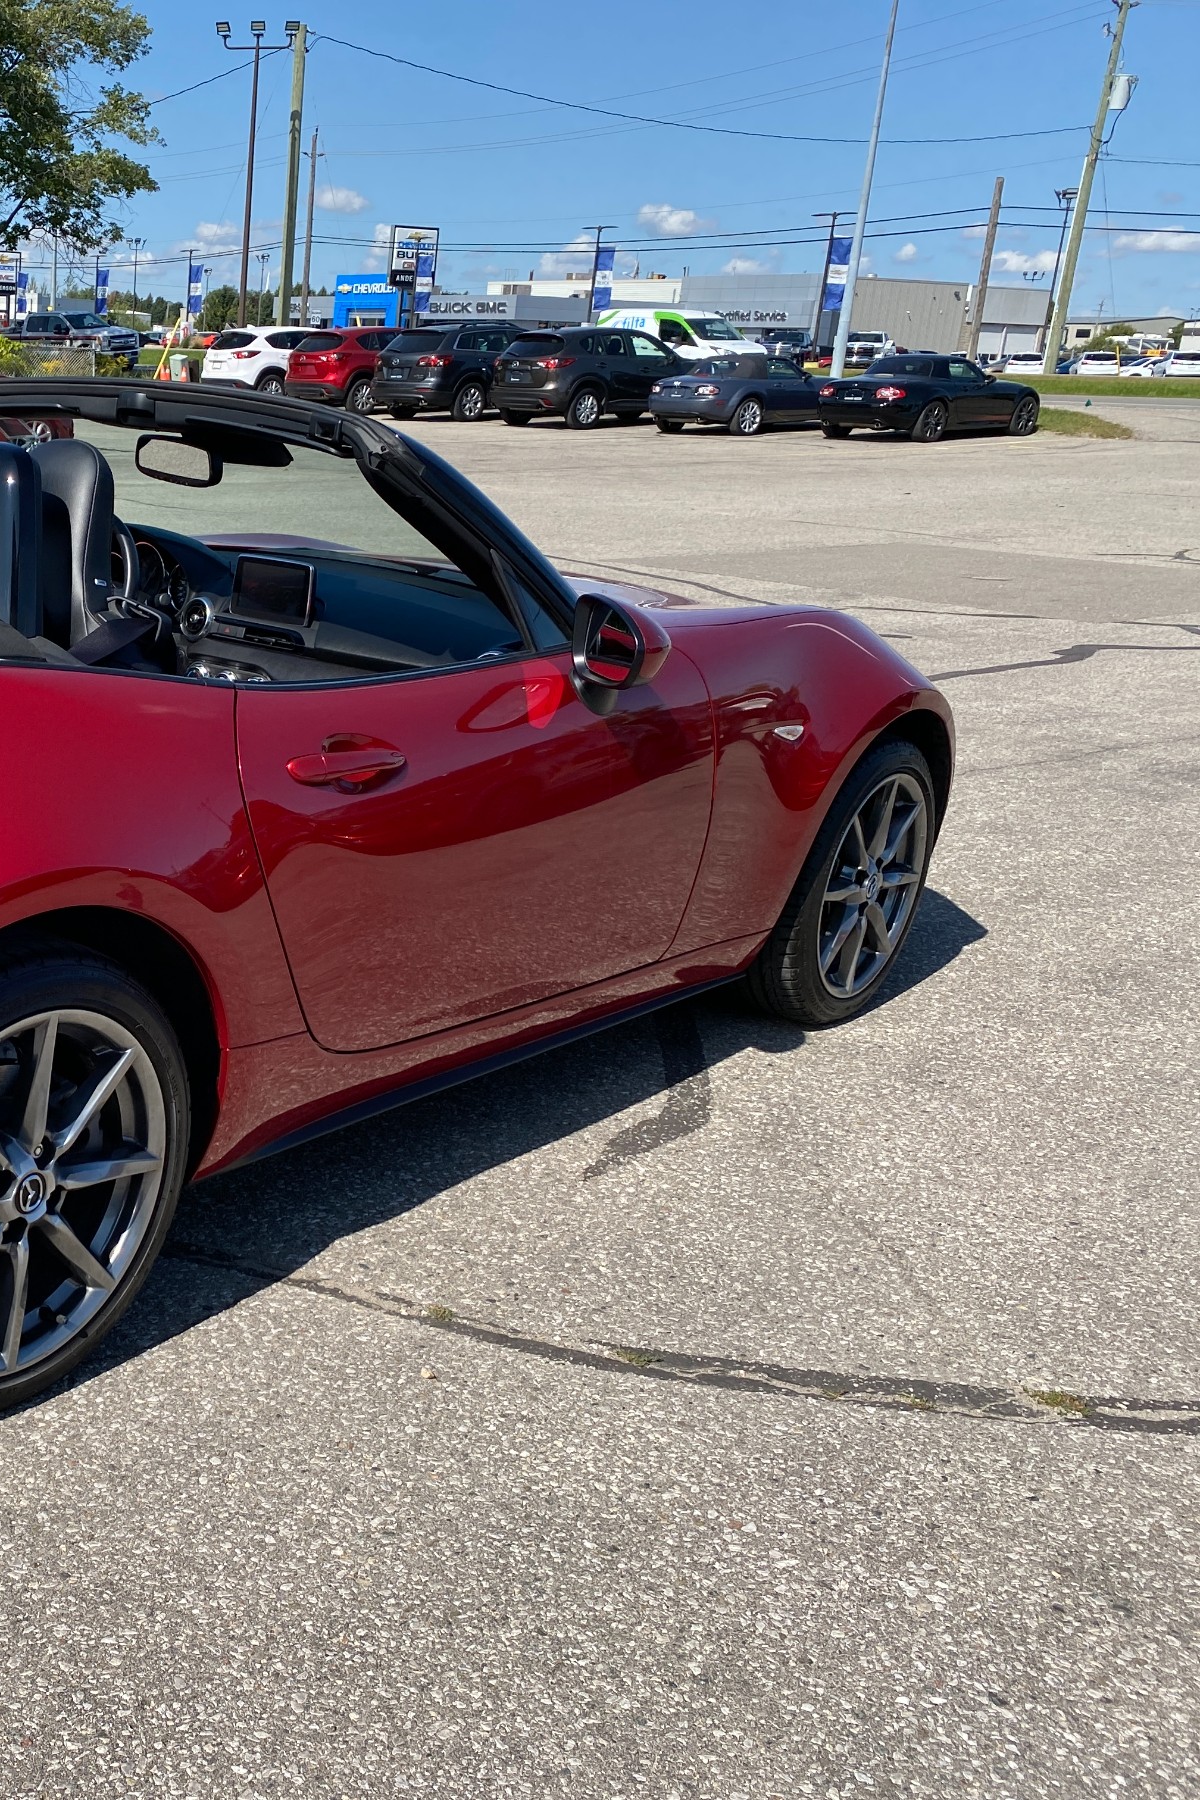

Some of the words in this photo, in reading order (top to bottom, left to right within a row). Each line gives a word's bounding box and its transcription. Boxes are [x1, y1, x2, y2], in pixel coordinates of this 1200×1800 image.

[352, 283, 396, 294] CHEVROLET
[430, 302, 472, 314] BUICK
[476, 302, 507, 314] GMC
[311, 315, 320, 323] 60
[754, 310, 787, 321] Service
